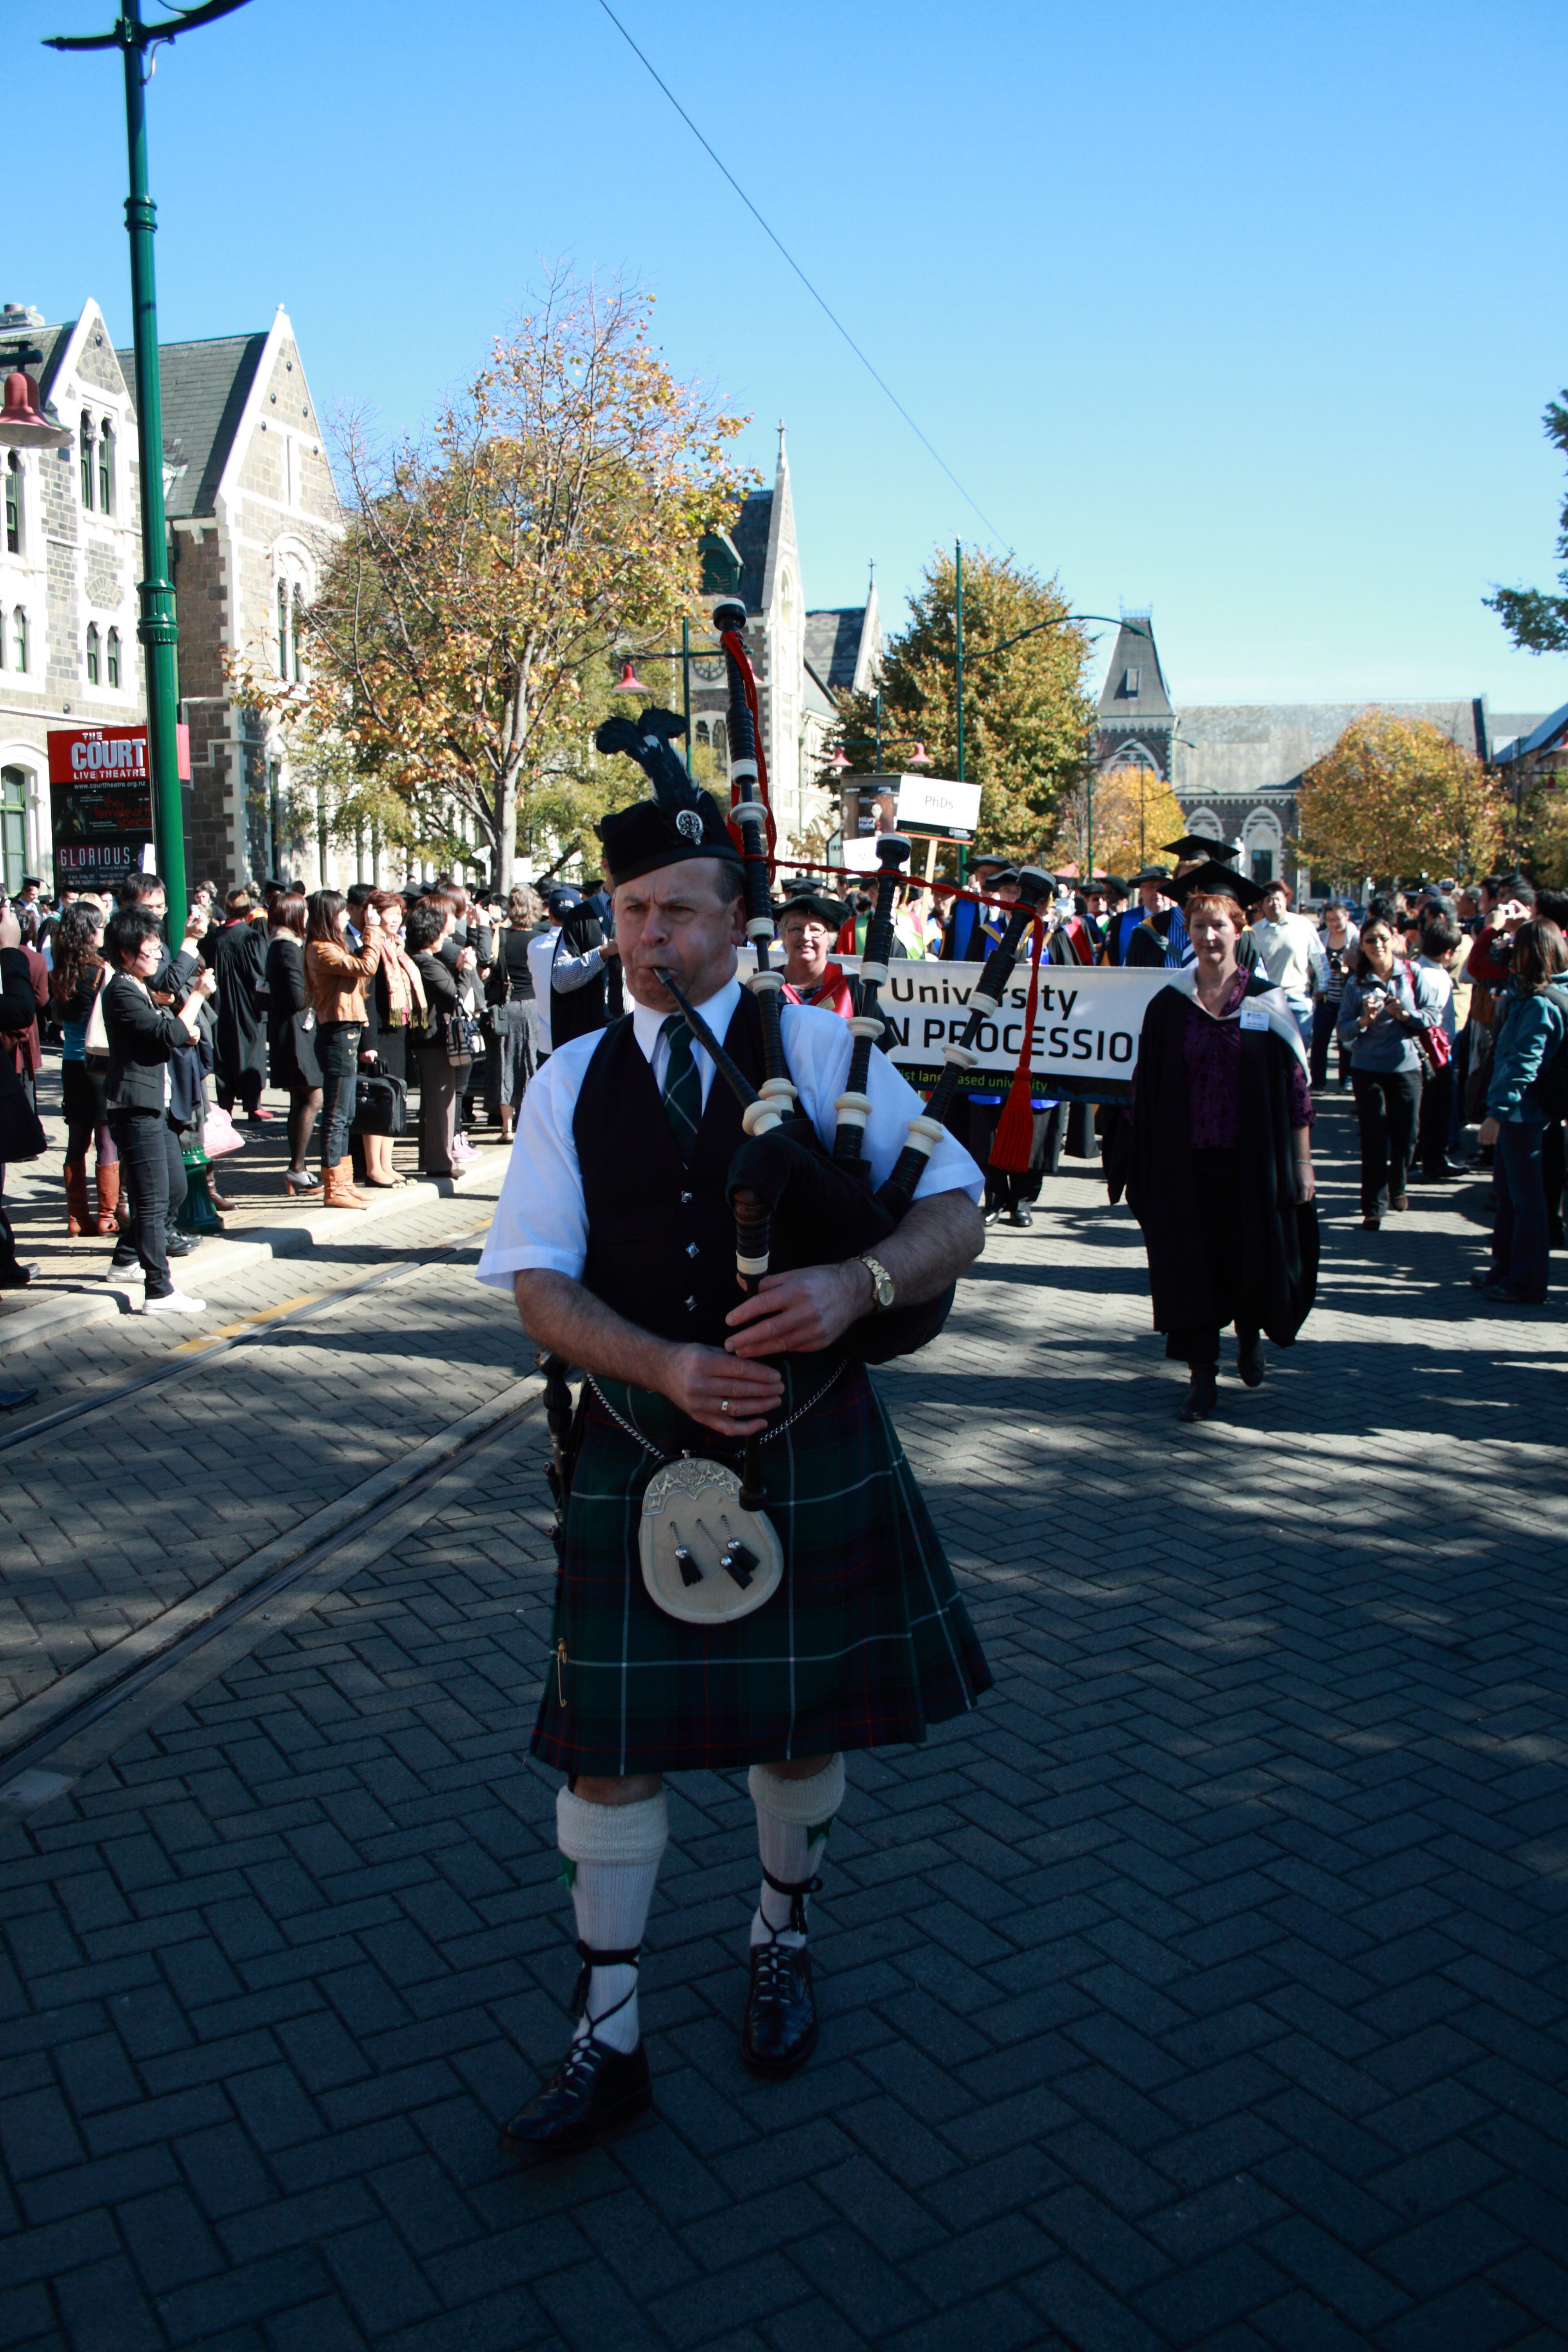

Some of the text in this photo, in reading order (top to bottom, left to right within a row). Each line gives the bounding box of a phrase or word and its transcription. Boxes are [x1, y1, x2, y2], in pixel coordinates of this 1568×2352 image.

[82, 732, 102, 740] THE
[71, 739, 146, 770] COURT
[73, 768, 146, 780] LIVE THEATRE
[925, 795, 954, 809] PhDs
[60, 846, 130, 866] GLORIOUS
[891, 977, 1078, 1020] Univrsty
